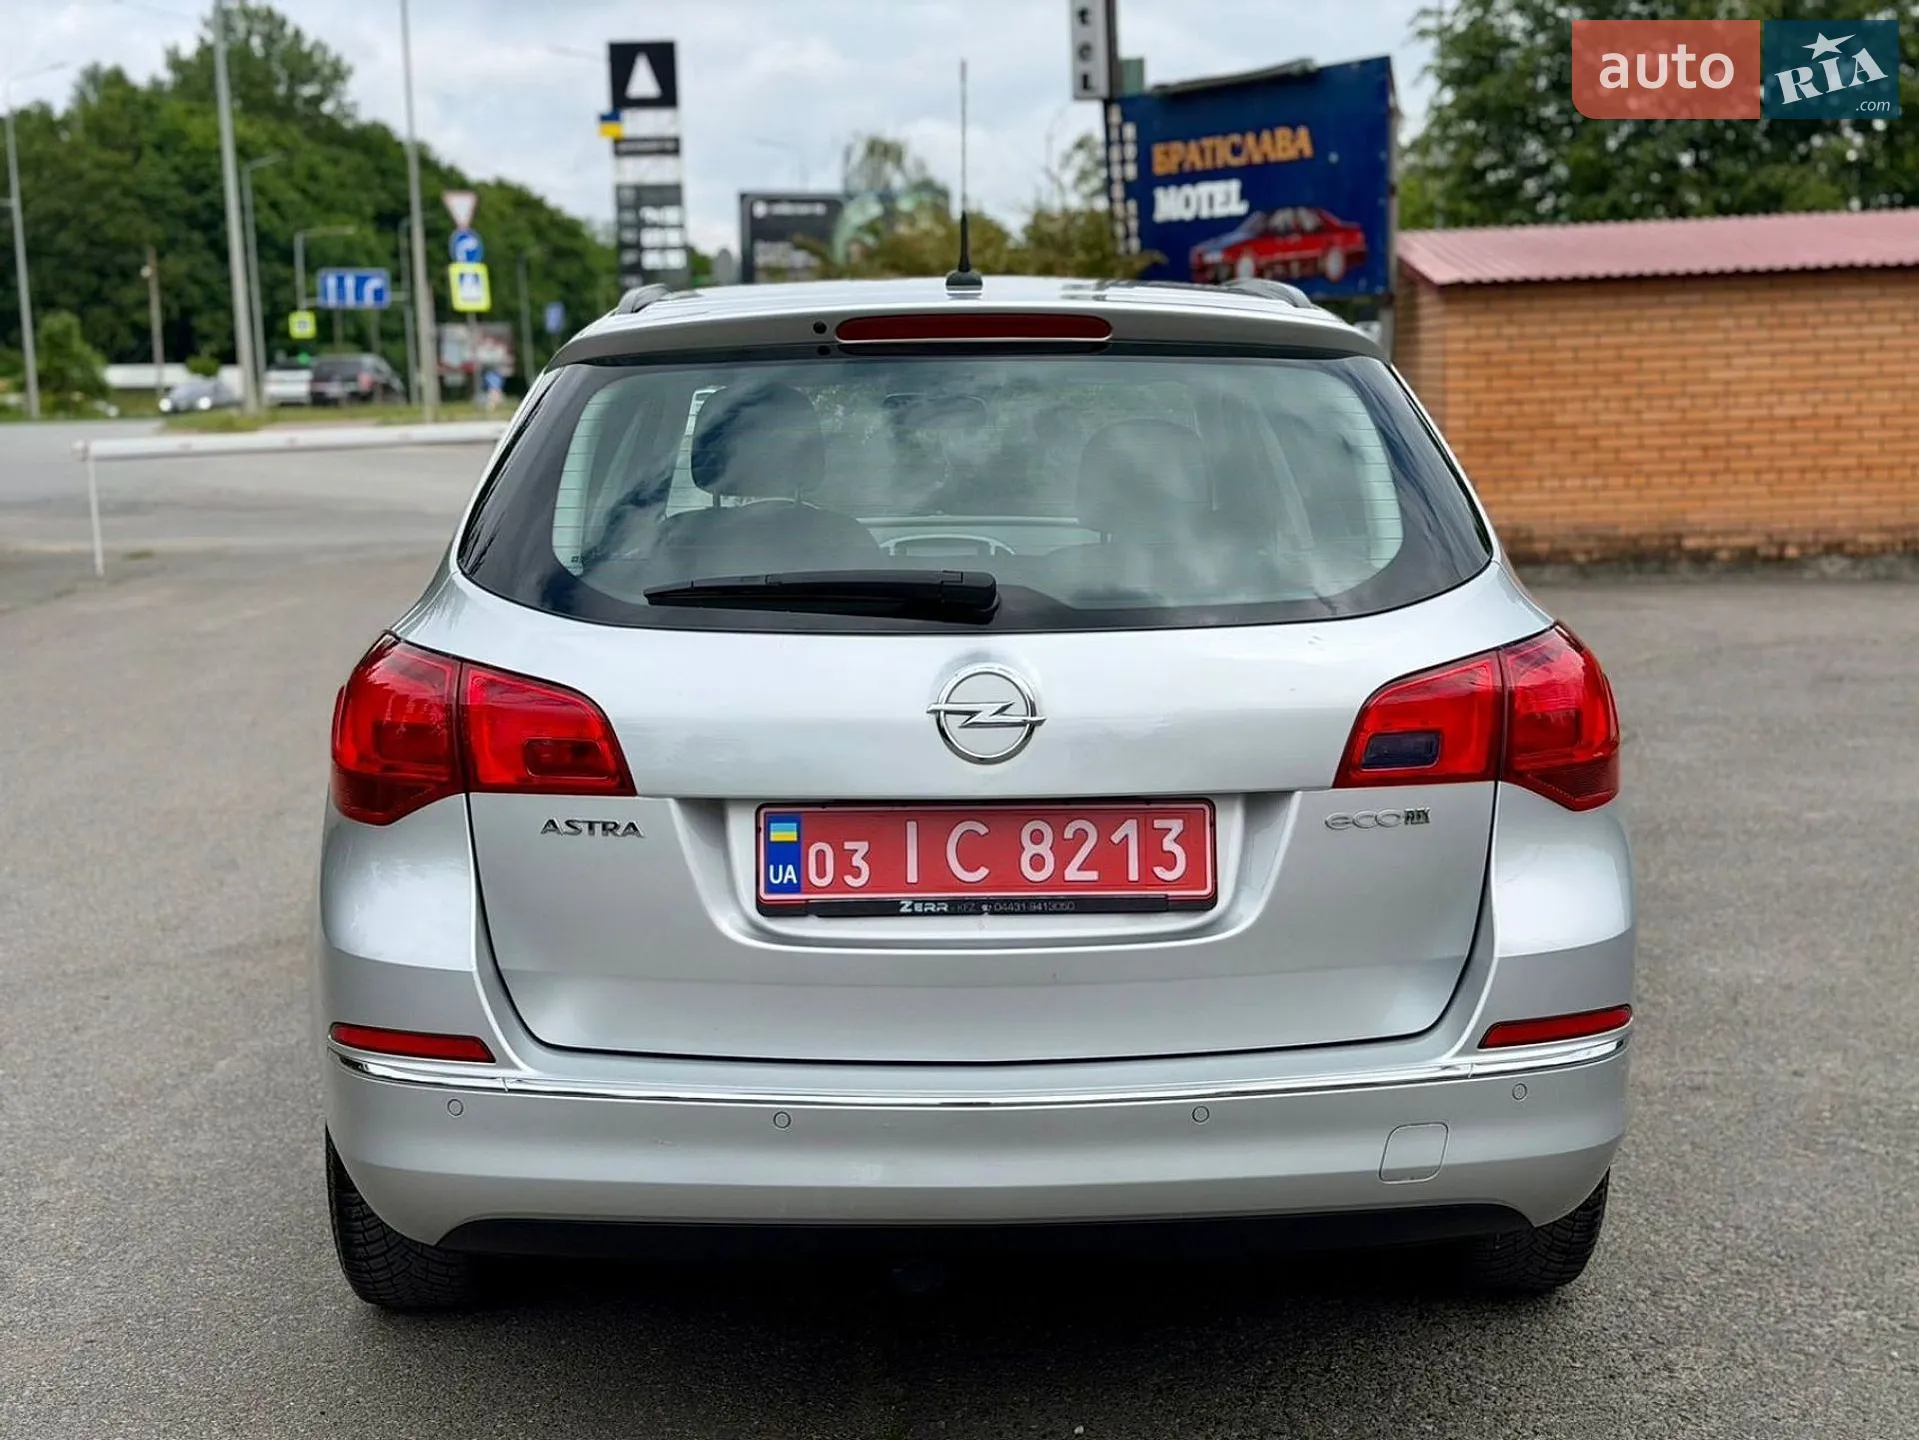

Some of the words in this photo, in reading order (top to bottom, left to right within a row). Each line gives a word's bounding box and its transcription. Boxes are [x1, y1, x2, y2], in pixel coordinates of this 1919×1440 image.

[1152, 124, 1313, 176] БРАТІСЛАВА
[1152, 178, 1249, 223] MOTEL
[540, 817, 645, 838] ASTRA
[807, 841, 870, 888] 03
[1019, 818, 1188, 883] 8213
[769, 864, 797, 884] UA
[900, 900, 949, 913] ZERR
